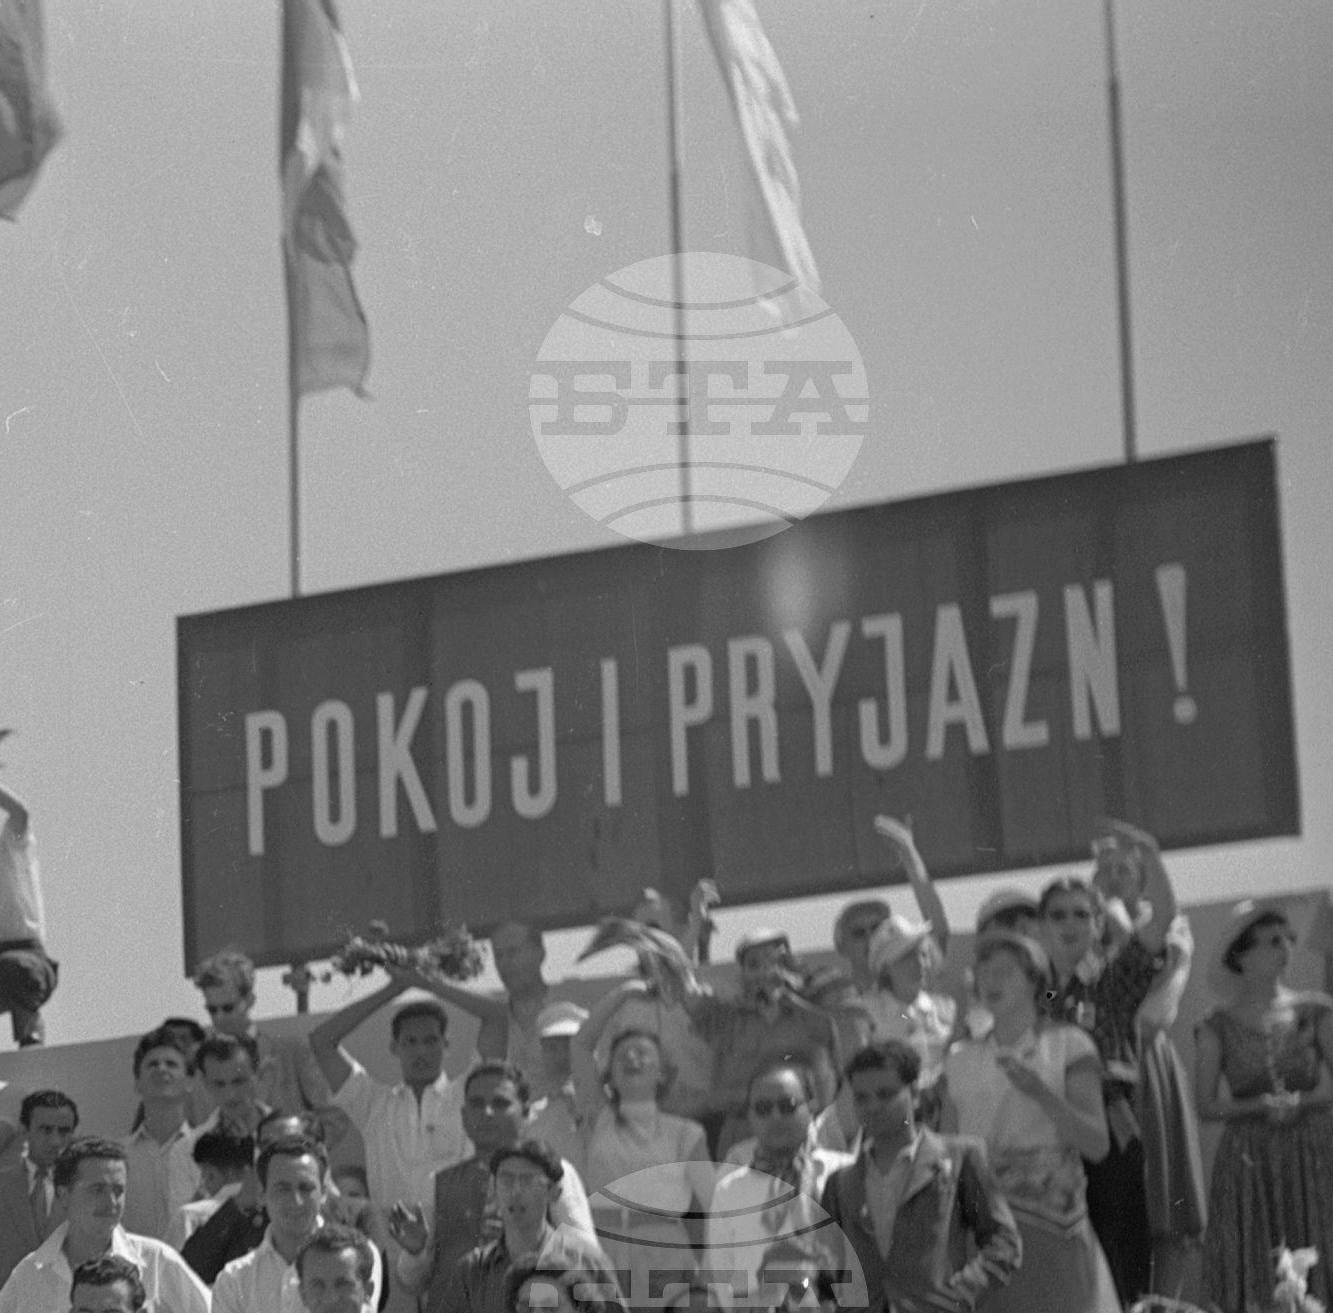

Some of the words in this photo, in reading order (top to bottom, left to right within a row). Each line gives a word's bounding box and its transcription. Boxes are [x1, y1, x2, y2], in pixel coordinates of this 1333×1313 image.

[244, 668, 558, 856] POKOJ
[600, 658, 623, 807] I
[668, 580, 1122, 799] PRYJAZN
